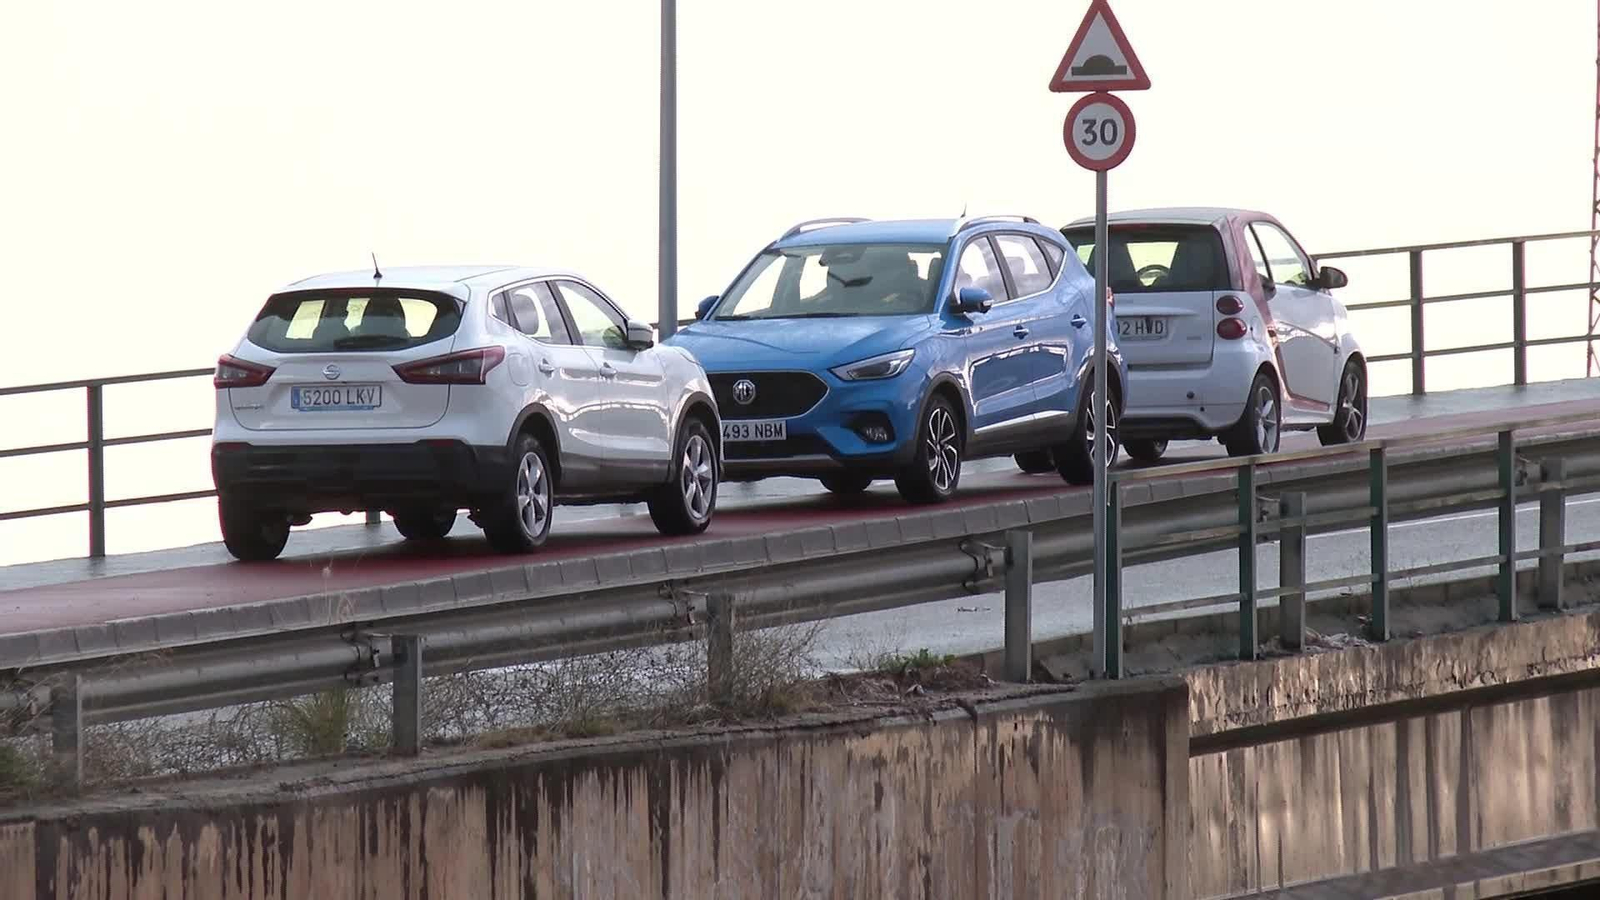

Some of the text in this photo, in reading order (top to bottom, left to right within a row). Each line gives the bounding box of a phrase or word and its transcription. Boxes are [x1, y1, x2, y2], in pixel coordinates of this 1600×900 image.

[1082, 118, 1118, 146] 30
[303, 388, 375, 406] 5200 LKV
[755, 422, 783, 438] NBM
